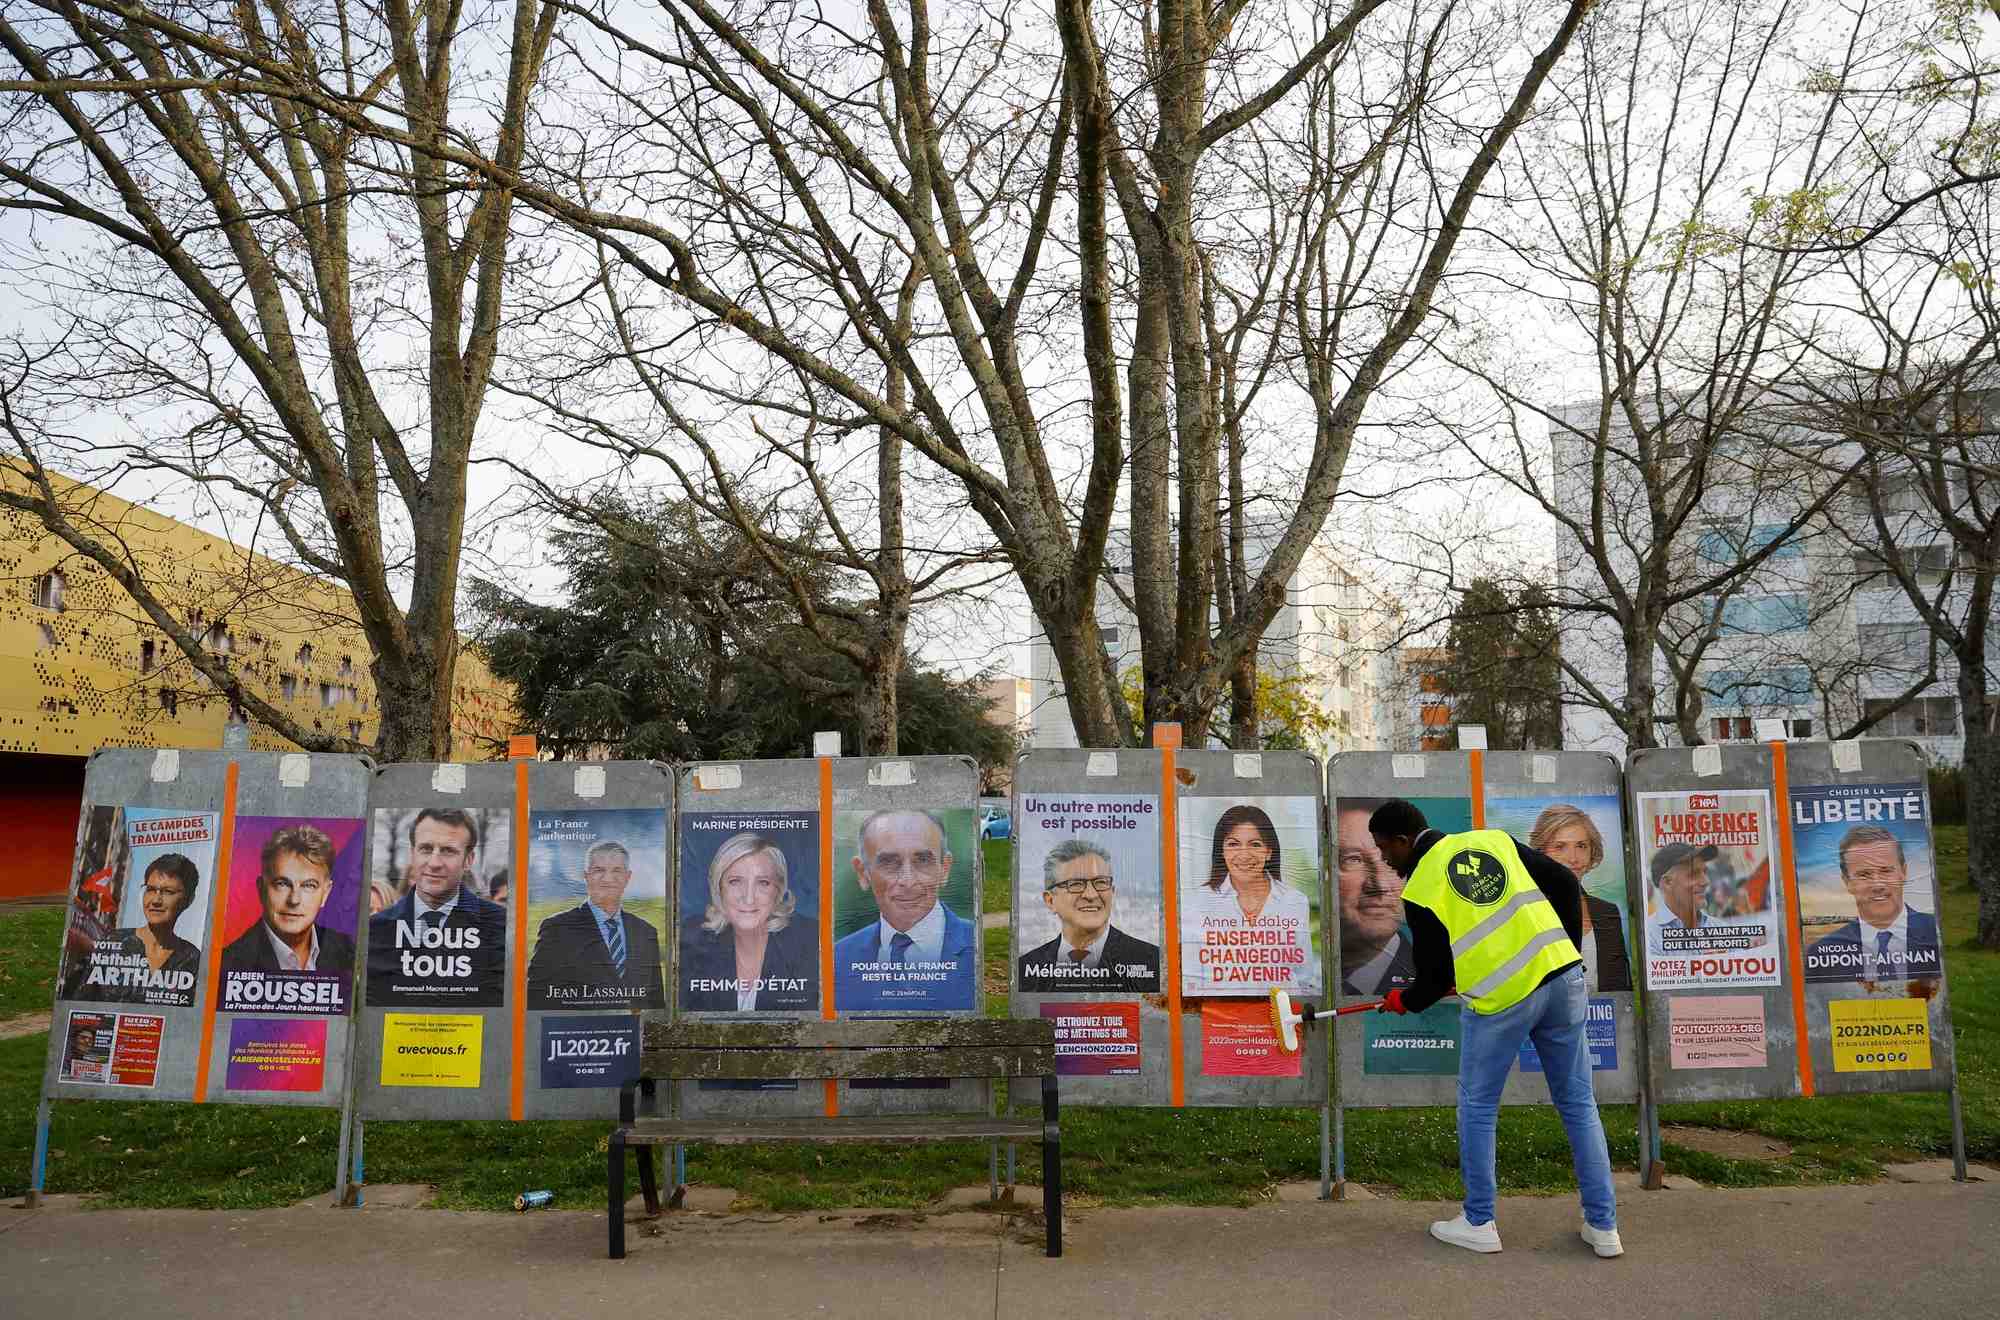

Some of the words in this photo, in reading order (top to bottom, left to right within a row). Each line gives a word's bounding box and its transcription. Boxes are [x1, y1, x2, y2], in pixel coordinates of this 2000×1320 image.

[1828, 789, 1870, 797] CHOISIR
[1026, 800, 1047, 813] Un
[1050, 801, 1095, 813] autre
[1097, 800, 1153, 814] monde
[1795, 791, 1921, 824] LIBERTÉ
[135, 822, 148, 832] LE
[151, 820, 182, 831] CAMP
[183, 818, 204, 829] DES
[538, 820, 551, 829] La
[554, 820, 589, 829] France
[692, 820, 737, 830] MARINE
[739, 817, 809, 830] PRÉSIDENTE
[1041, 816, 1066, 829] est
[1071, 815, 1137, 832] possible
[1654, 811, 1759, 833] L'URGENCE
[130, 828, 209, 844] TRAVAILLEURS
[537, 831, 597, 842] authentique
[1657, 832, 1758, 848] ANTICAPITALISTE
[1201, 916, 1237, 928] Anne
[1241, 916, 1299, 929] Hidalgo
[395, 919, 481, 949] Nous
[1206, 930, 1296, 946] ENSEMBLE
[1663, 929, 1684, 938] NOS
[1685, 928, 1705, 937] VIES
[1706, 927, 1740, 936] VALENT
[1741, 926, 1764, 935] PLUS
[94, 941, 123, 951] VOTEZ
[1664, 941, 1683, 950] QUE
[1685, 940, 1712, 949] LEURS
[1713, 939, 1749, 948] PROFITS
[1817, 944, 1858, 953] NICOLAS
[90, 953, 148, 967] Nathalie
[1199, 948, 1304, 964] CHANGEONS
[1807, 949, 1936, 969] DUPONT-AIGNAN
[400, 950, 473, 977] tous
[851, 962, 879, 971] POUR
[881, 962, 903, 972] QUE
[904, 962, 916, 971] LA
[918, 961, 958, 971] FRANCE
[1651, 960, 1687, 970] VOTEZ
[1690, 957, 1776, 977] POUTOU
[227, 971, 264, 981] FABIEN
[862, 973, 892, 981] RESTE
[894, 973, 906, 981] LA
[907, 972, 947, 981] FRANCE
[1024, 964, 1110, 978] Mélenchon
[1213, 966, 1291, 982] D'AVENIR
[1651, 969, 1687, 978] PHILIPPE
[86, 966, 195, 991] ARTHAUD
[690, 979, 748, 992] FEMME
[752, 974, 808, 992] D'ÉTAT
[225, 980, 343, 1004] ROUSSEL
[546, 984, 578, 998] JEAN
[583, 984, 647, 998] LASSALLE
[1587, 1004, 1613, 1020] TING
[1056, 1016, 1101, 1027] RETROUVEZ
[1103, 1016, 1123, 1026] TOUS
[1071, 1028, 1111, 1038] MEETINGS
[1112, 1028, 1128, 1038] SUR
[1672, 1024, 1762, 1034] POUTOU2022.ORG
[1836, 1023, 1925, 1038] 2022NDA.FR
[398, 1044, 467, 1056] avecvous.fr
[548, 1037, 631, 1061] JL2022.fr
[1055, 1045, 1136, 1053] LENCHON2022.FR
[1371, 1039, 1455, 1049] JADOT2022.FR
[230, 1055, 321, 1064] FABIENROUSSEL2022.FR
